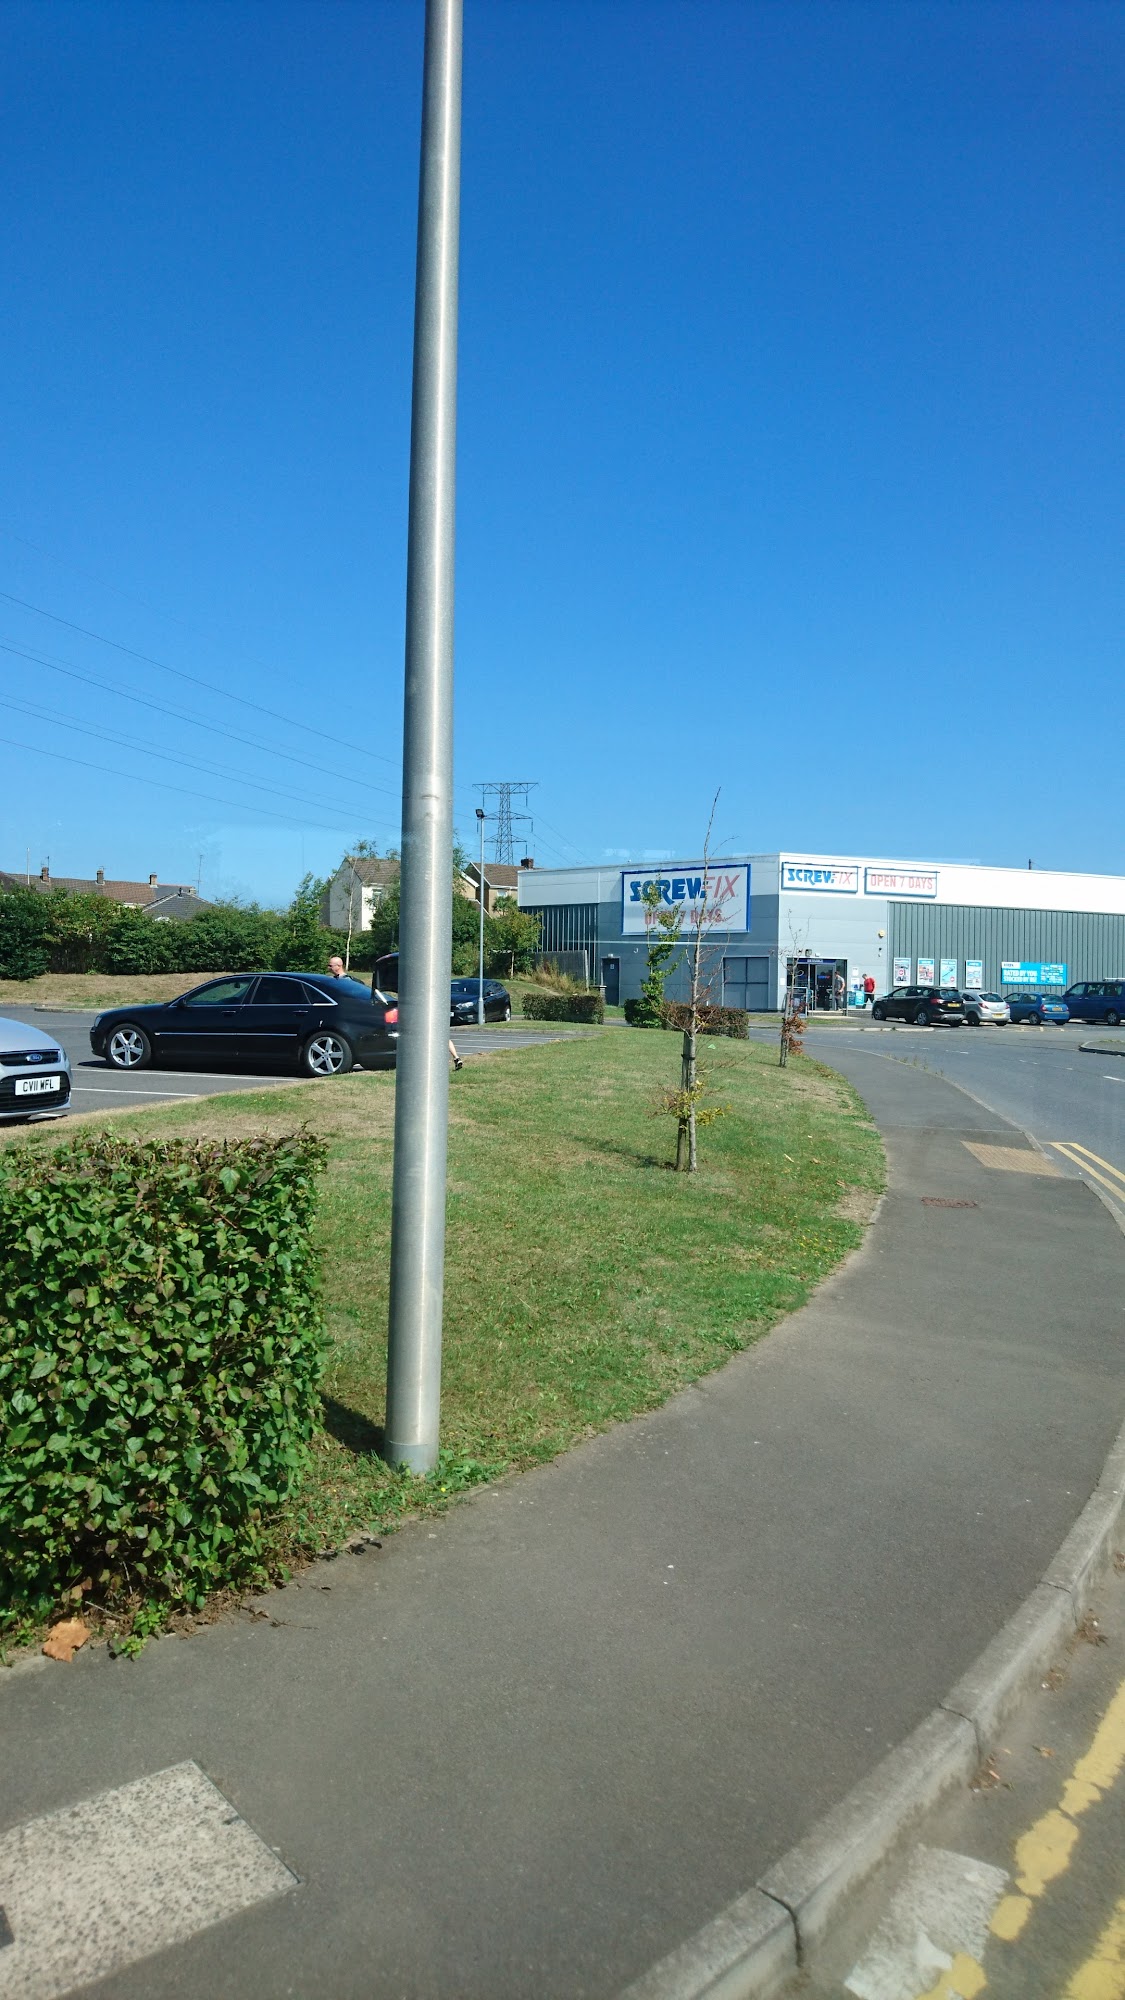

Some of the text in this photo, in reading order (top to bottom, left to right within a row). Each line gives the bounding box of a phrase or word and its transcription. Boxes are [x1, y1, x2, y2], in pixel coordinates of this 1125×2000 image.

[788, 868, 853, 886] SCREWFIX
[870, 874, 933, 890] OPEN 7 DAYS
[644, 910, 676, 925] OP
[40, 1079, 54, 1091] WFL
